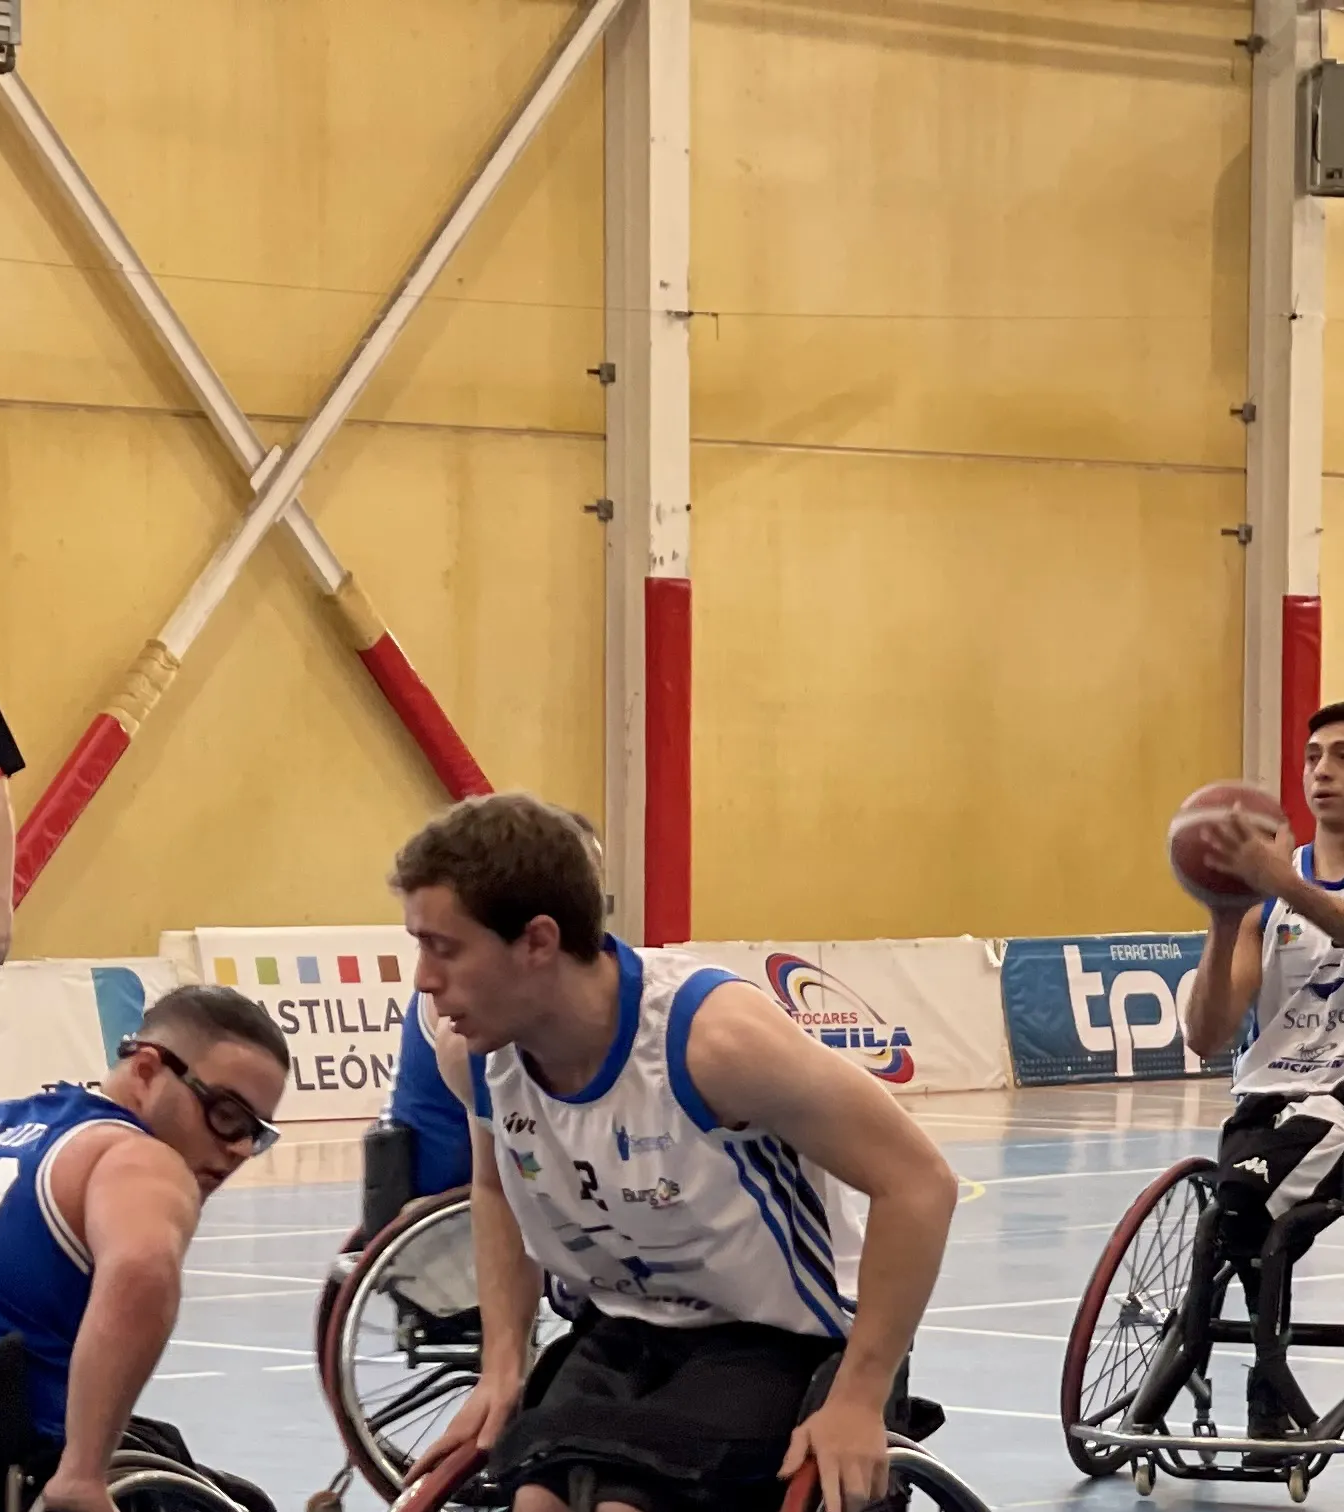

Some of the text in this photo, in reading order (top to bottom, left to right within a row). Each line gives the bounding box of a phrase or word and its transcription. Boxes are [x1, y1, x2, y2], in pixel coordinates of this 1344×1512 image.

[258, 998, 404, 1034] STILLA
[792, 1012, 859, 1025] TOCARES
[292, 1044, 396, 1091] LEÓN
